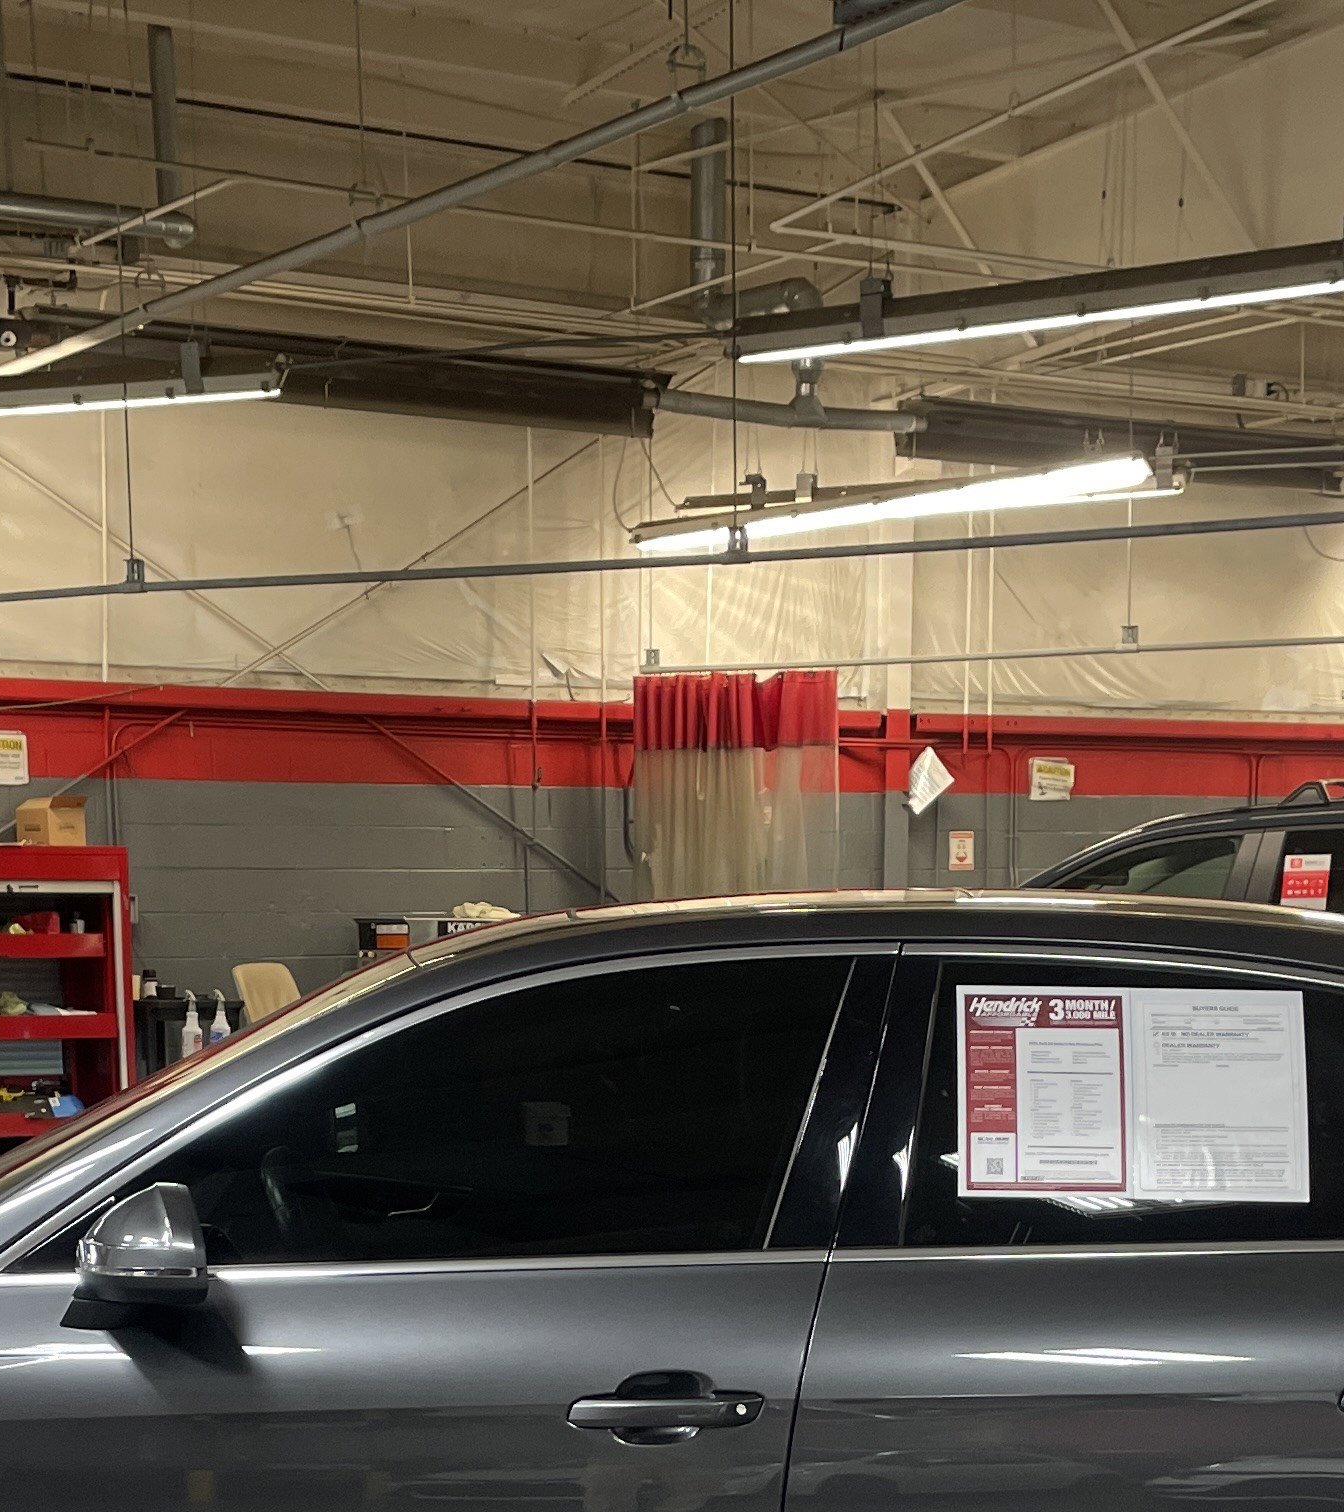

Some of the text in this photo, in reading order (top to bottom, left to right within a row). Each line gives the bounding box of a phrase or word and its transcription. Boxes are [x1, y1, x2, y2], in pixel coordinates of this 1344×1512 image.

[969, 997, 1042, 1017] Hendrick
[1049, 998, 1065, 1020] 3
[1093, 1010, 1117, 1020] MILE
